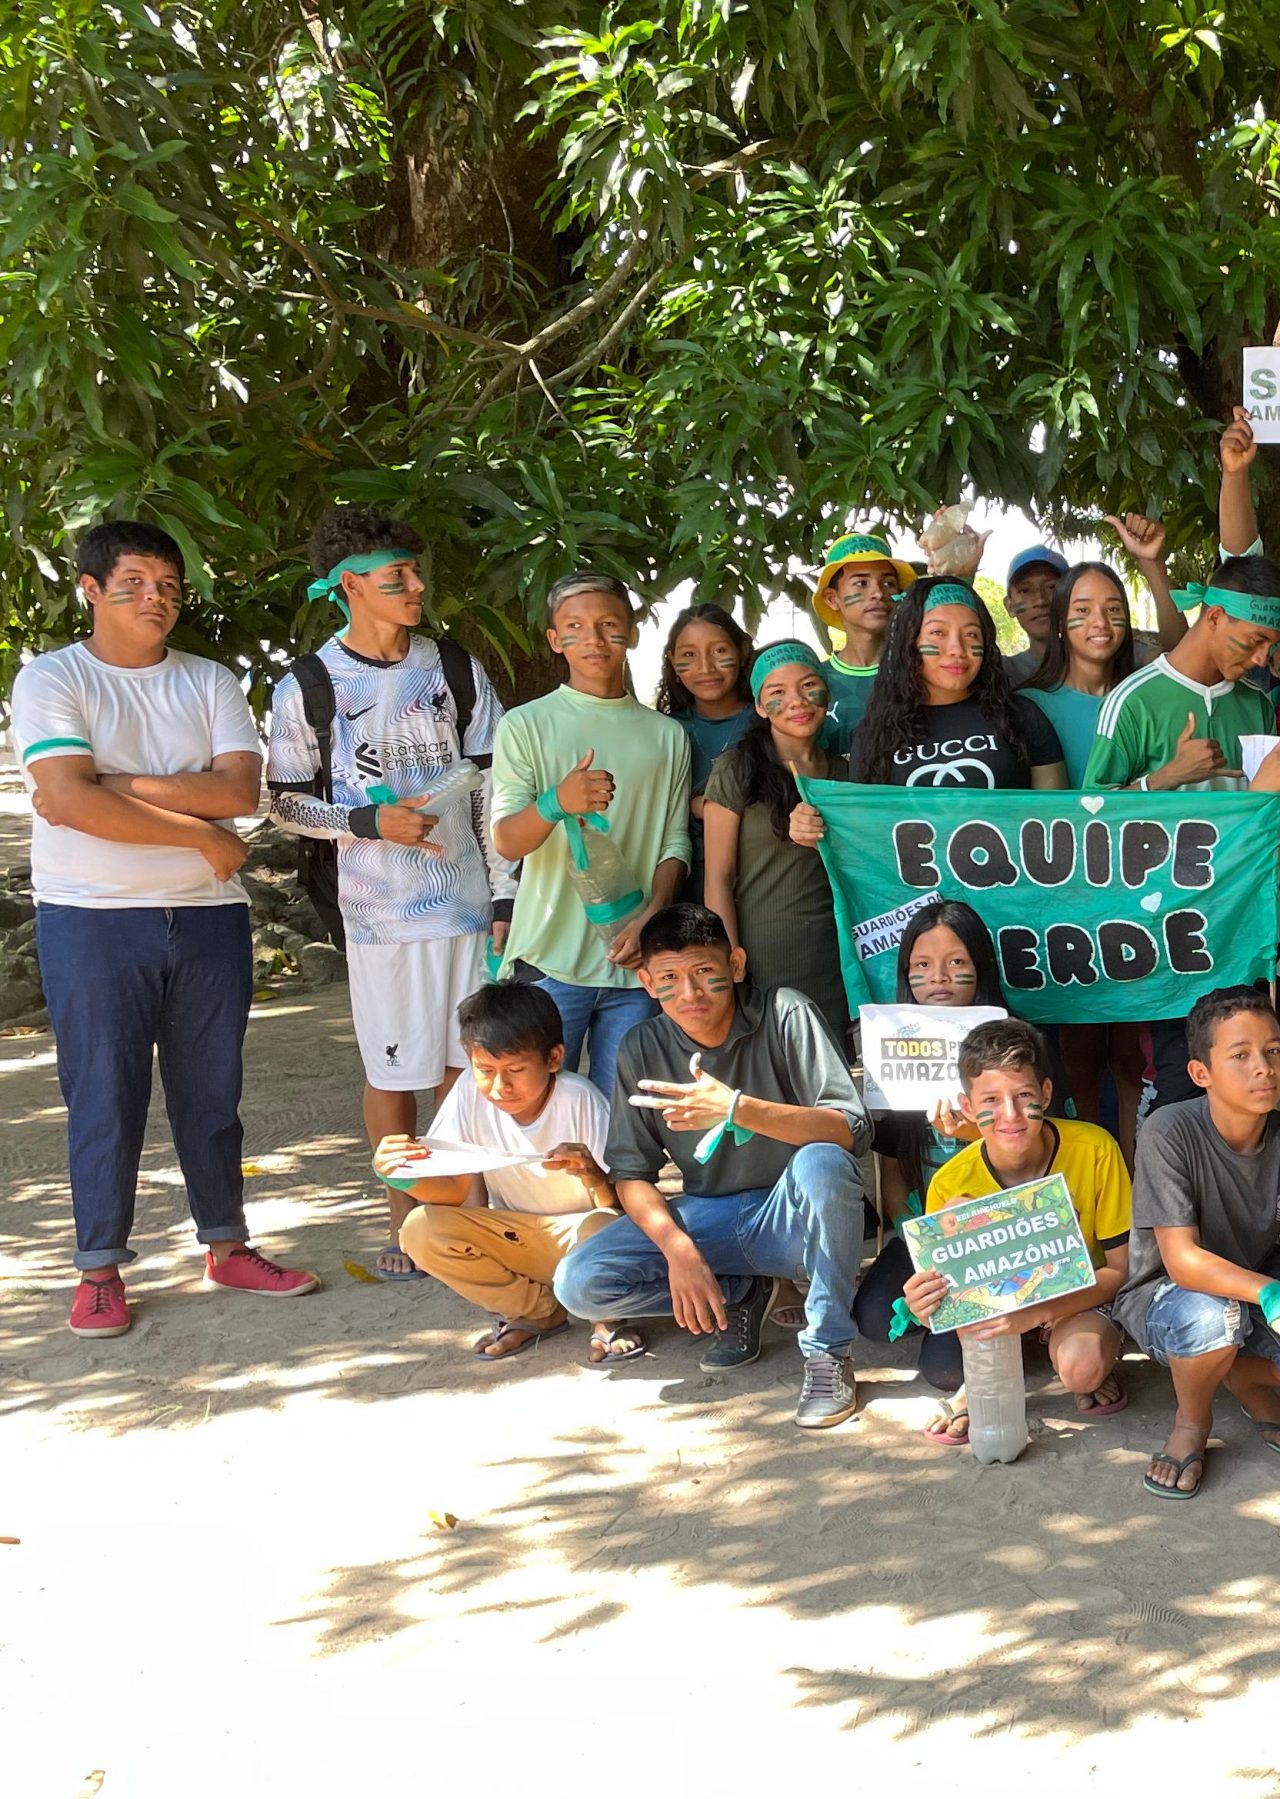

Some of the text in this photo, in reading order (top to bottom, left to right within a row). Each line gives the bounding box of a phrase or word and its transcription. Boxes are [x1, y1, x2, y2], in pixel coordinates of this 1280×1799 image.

[893, 734, 998, 765] GUCCI
[892, 818, 1220, 891] EQUIPE
[991, 908, 1215, 991] ERDE
[880, 1056, 960, 1081] AMAZÔ
[883, 1040, 944, 1057] TODOS
[931, 1211, 1059, 1265] GUARDIÕES
